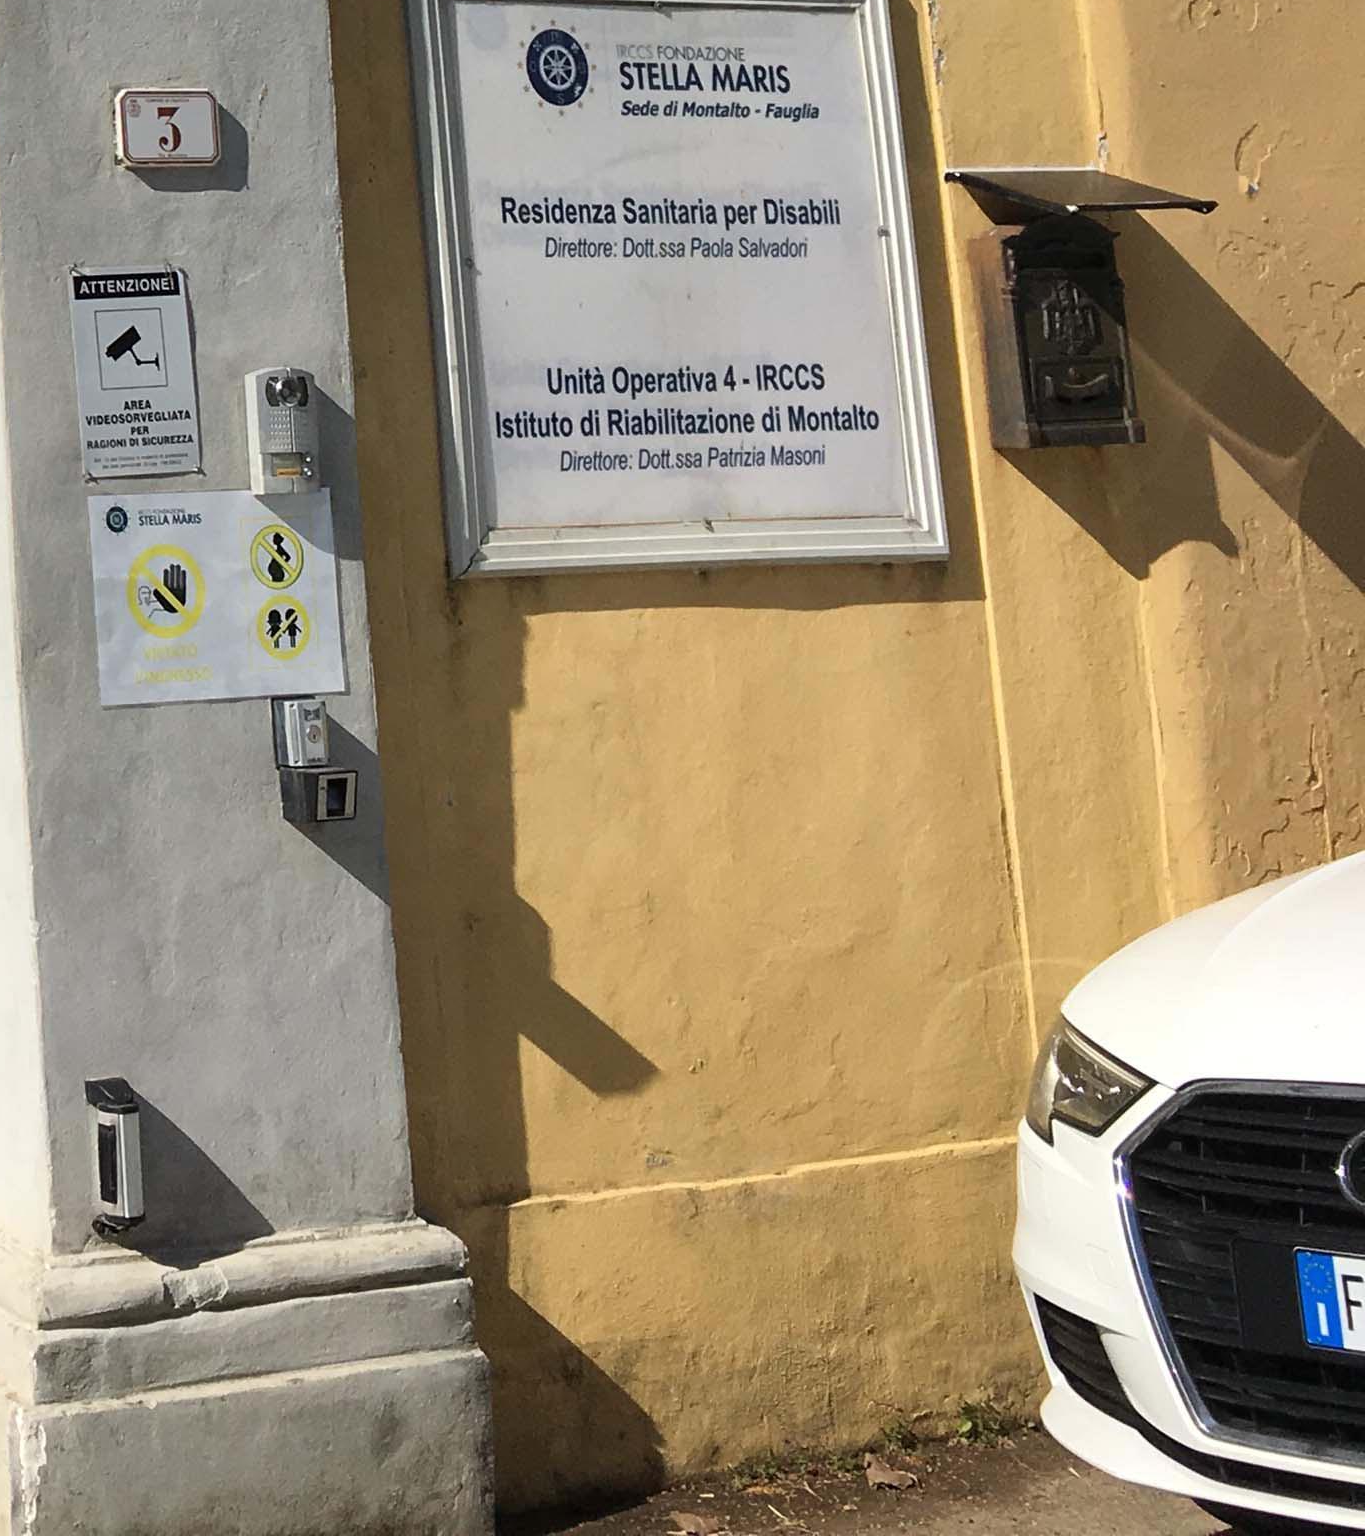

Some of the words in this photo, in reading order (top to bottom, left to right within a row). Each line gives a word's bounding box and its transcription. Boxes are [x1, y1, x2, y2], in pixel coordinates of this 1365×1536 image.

[616, 44, 654, 59] IRCCS
[657, 45, 745, 62] FONDAZIONE
[619, 61, 703, 92] STELLA
[712, 63, 791, 93] MARIS
[621, 100, 659, 117] Sede
[663, 100, 678, 117] di
[682, 101, 750, 119] Montalto
[765, 103, 819, 122] Fauglia
[156, 106, 181, 152] 3
[500, 197, 616, 224] Residenza
[623, 197, 717, 224] Sanitaria
[725, 204, 758, 230] per
[763, 199, 841, 225] Disabili
[545, 237, 617, 257] Direttore:
[623, 237, 685, 257] Dott.ssa
[690, 237, 733, 257] Paola
[738, 237, 808, 257] Salvadori
[547, 366, 605, 395] Unità
[612, 366, 717, 399] Operativa
[723, 365, 737, 391] 4
[756, 363, 826, 391] IRCCS
[124, 400, 152, 411] AREA
[85, 410, 192, 426] VIDEOSORVEGLIATA
[495, 410, 573, 439] Istituto
[580, 409, 600, 437] di
[608, 407, 754, 436] Riabilitazione
[761, 405, 781, 433] di
[788, 404, 879, 432] Montalto
[130, 426, 150, 435] PER
[87, 439, 127, 449] RAGIONI
[129, 438, 139, 447] DI
[141, 435, 194, 446] SICUREZZA
[560, 450, 633, 472] Direttore:
[638, 448, 702, 470] Dott.ssa
[708, 446, 765, 469] Patrizia
[770, 445, 826, 466] Masoni
[138, 514, 170, 527] STELLA
[172, 513, 203, 526] MARIS
[1341, 1274, 1364, 1331] F
